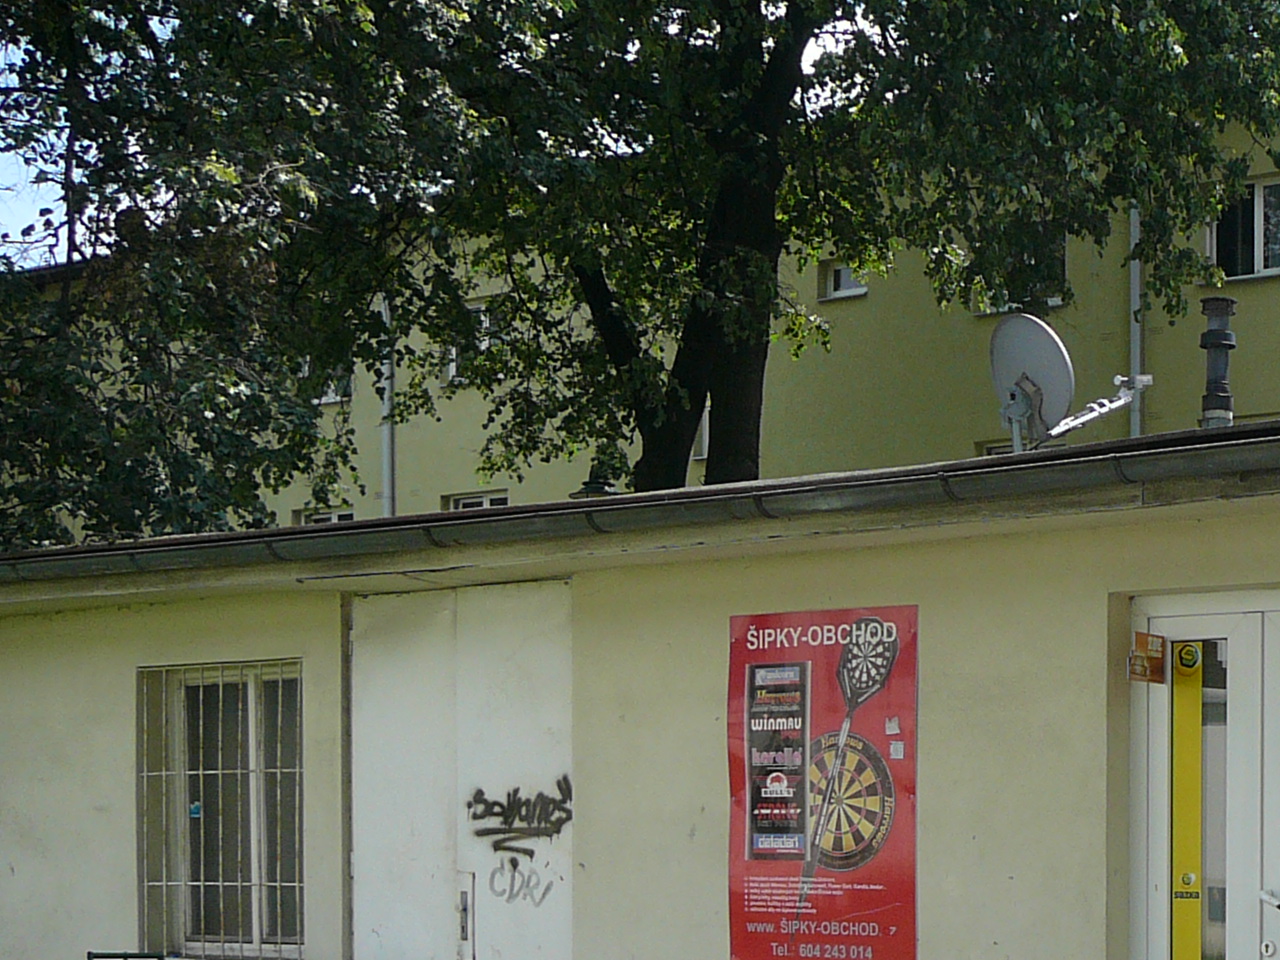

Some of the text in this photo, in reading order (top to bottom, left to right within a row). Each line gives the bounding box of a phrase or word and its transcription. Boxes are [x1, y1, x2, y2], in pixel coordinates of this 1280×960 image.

[746, 622, 897, 651] ŠIPKY-OBCHOD
[800, 943, 821, 958] 604
[824, 944, 847, 959] 243
[850, 945, 873, 960] 014
